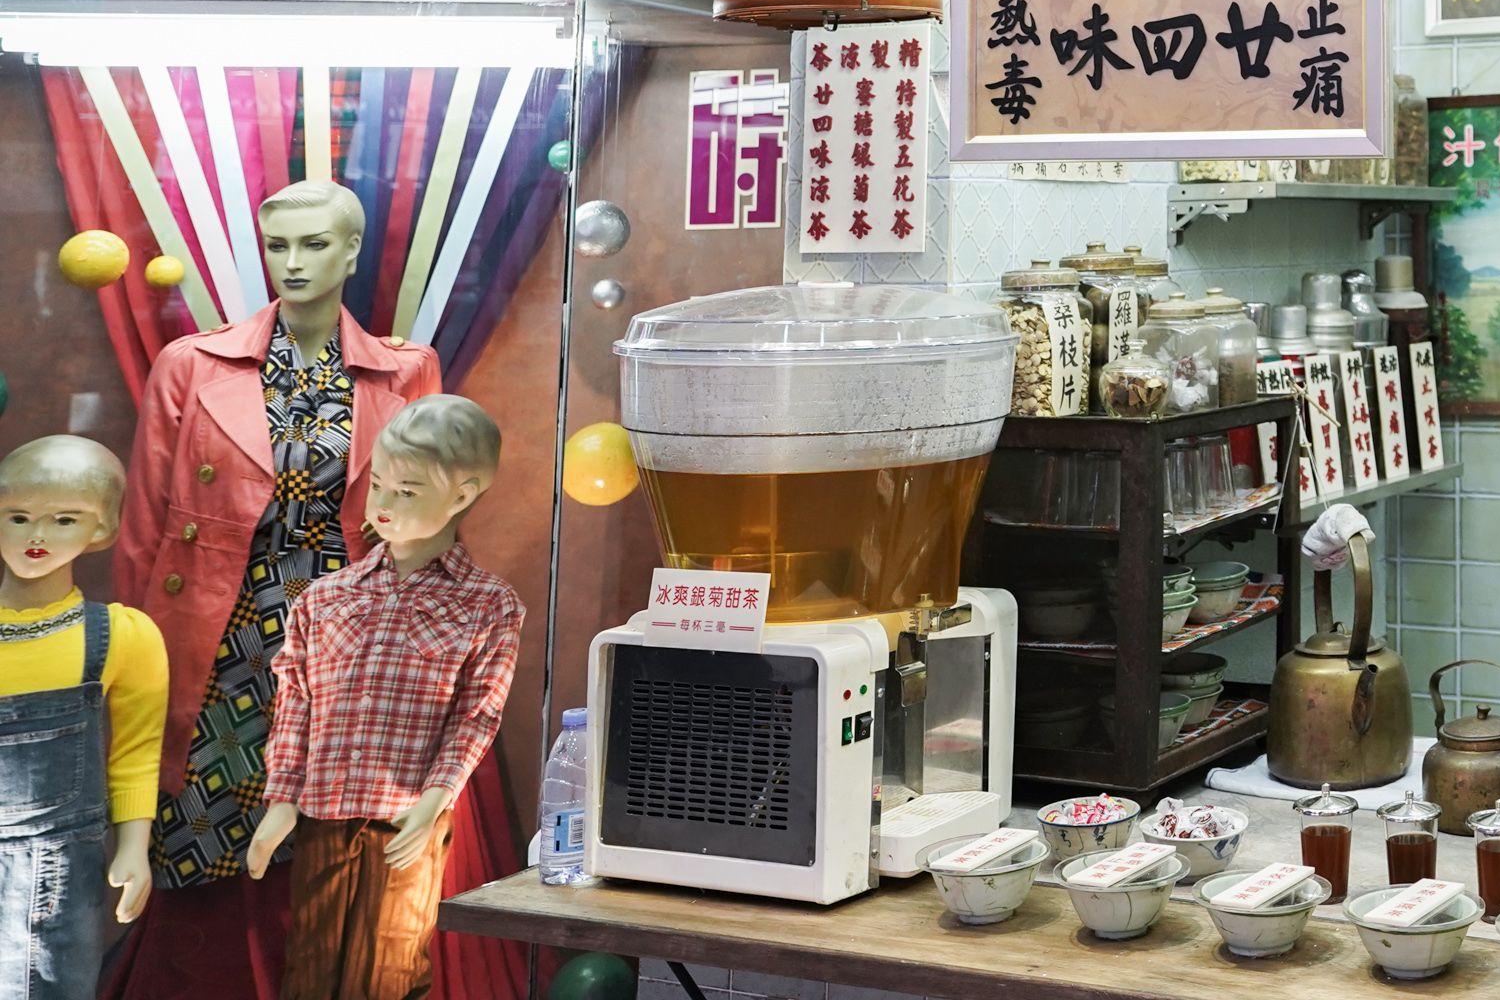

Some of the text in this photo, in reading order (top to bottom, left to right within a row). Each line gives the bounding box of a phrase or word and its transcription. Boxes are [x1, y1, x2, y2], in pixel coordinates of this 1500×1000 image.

[810, 38, 922, 71] 精製涼茶
[1050, 2, 1293, 91] 廿四味
[807, 83, 833, 241] 廿四味涼茶
[849, 77, 875, 239] 蜜糖銀菊茶
[891, 79, 917, 239] 特製五花茶
[1054, 299, 1078, 410] 桑枝片
[656, 584, 759, 609] 冰爽銀菊甜茶
[680, 619, 726, 633] 每杯三毫
